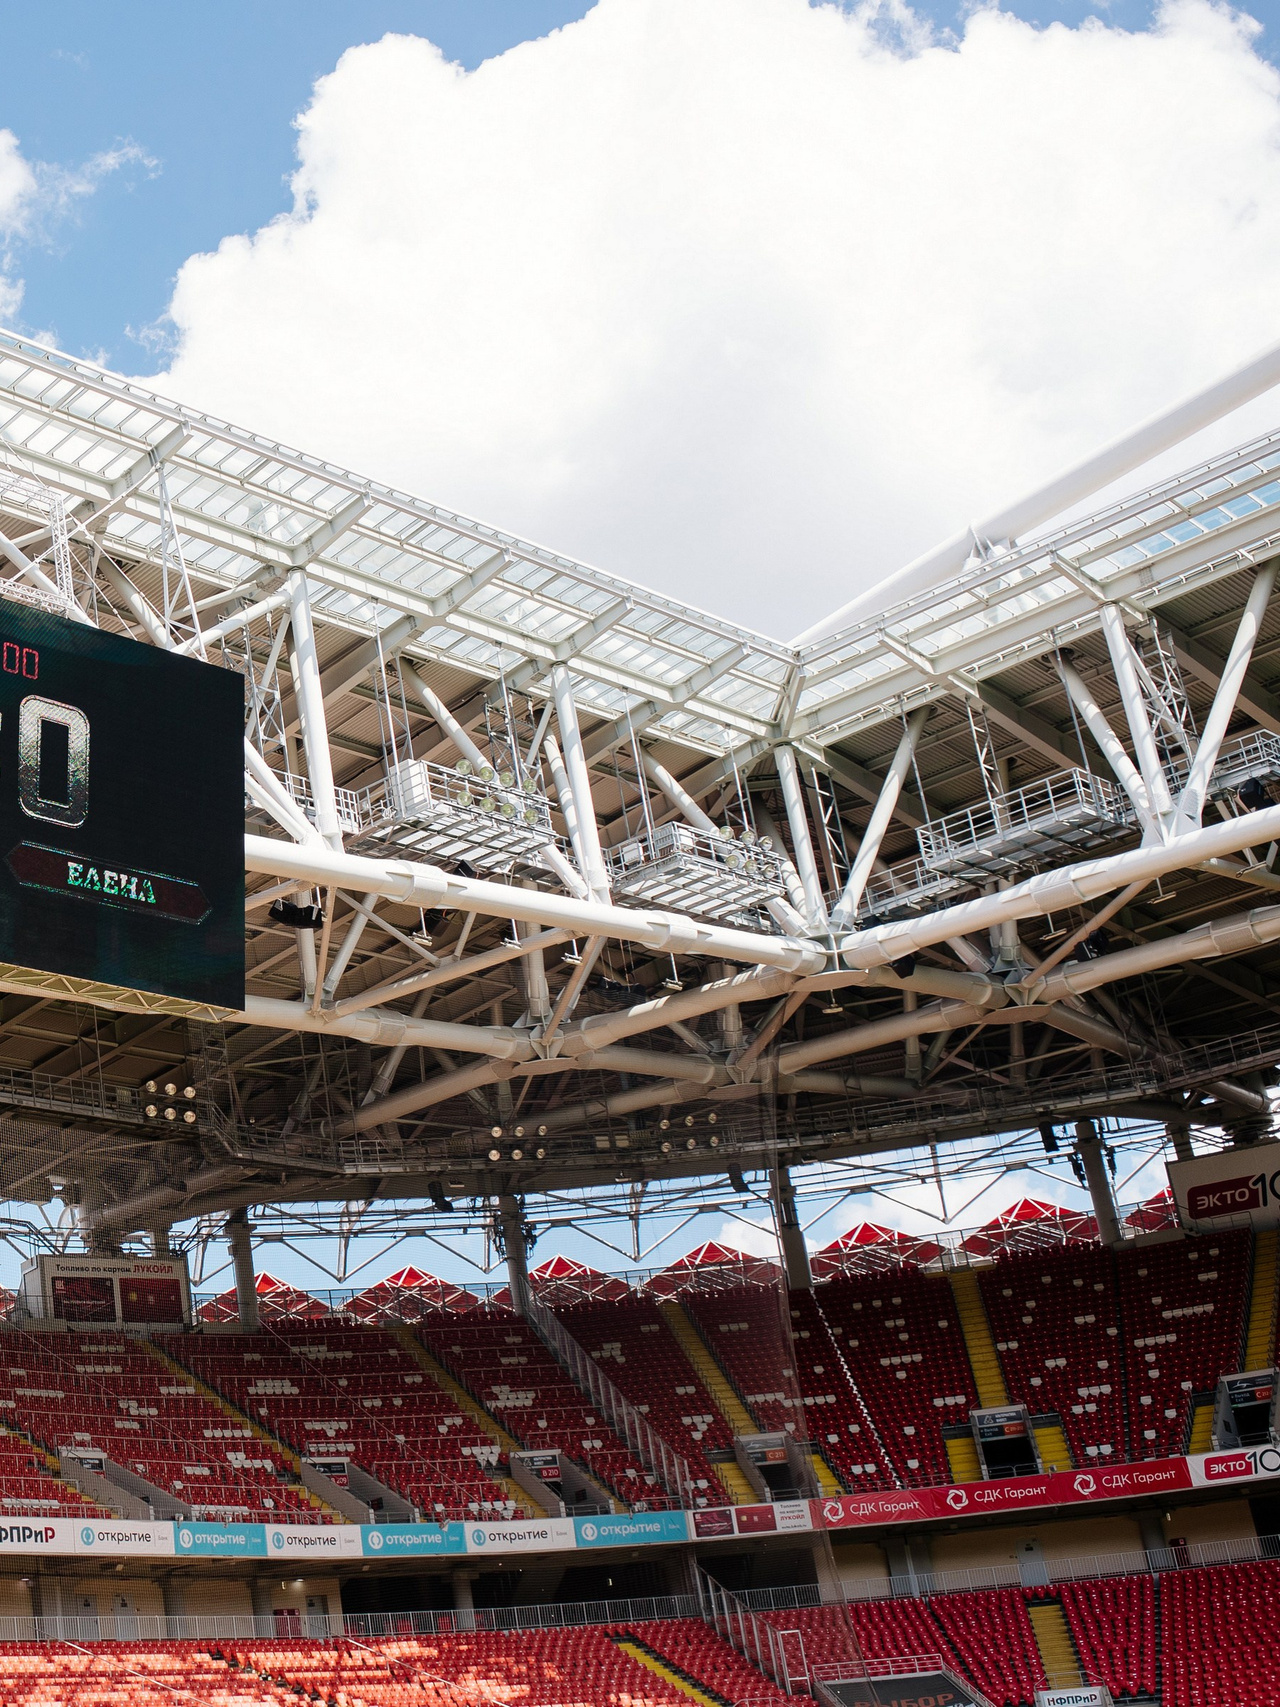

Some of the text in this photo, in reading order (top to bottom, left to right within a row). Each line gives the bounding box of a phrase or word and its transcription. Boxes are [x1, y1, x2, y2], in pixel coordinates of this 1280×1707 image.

[67, 861, 156, 903] ЕЛЕНА
[1197, 1188, 1249, 1209] ЭКТО
[56, 1264, 89, 1272] Топливо
[103, 1266, 131, 1274] картам
[133, 1263, 173, 1274] ЛУКОЙЛ
[1210, 1460, 1245, 1474] ЭКТО
[1102, 1469, 1176, 1488] СДК Гарант
[974, 1486, 1046, 1503] СДК Гарант
[850, 1500, 919, 1515] СДК Гарант
[488, 1528, 548, 1544] открытие
[600, 1522, 661, 1536] открытие
[97, 1529, 151, 1544] открытие
[195, 1532, 246, 1546] открытие
[286, 1535, 336, 1548] открытие
[386, 1533, 442, 1546] открытие
[1047, 1693, 1098, 1707] НФПРиР
